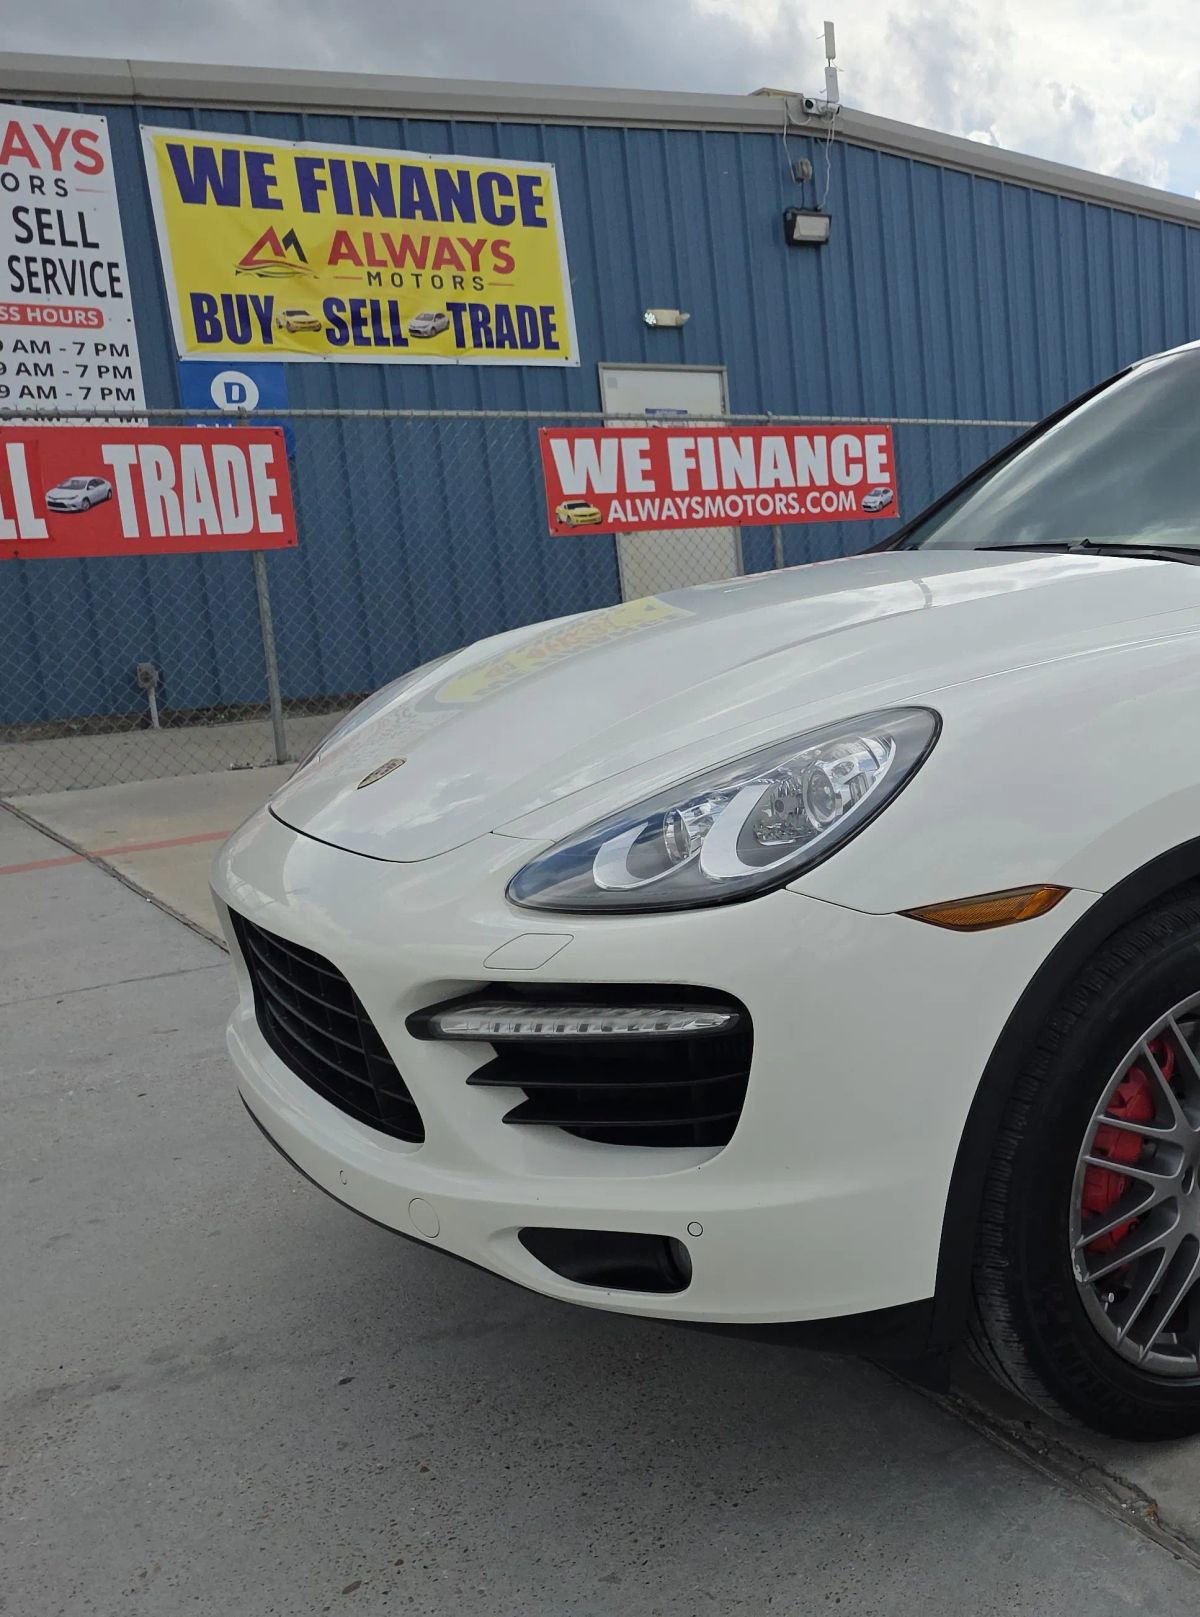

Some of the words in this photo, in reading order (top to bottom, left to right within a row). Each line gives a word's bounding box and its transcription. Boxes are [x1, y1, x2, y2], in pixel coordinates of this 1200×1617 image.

[0, 120, 104, 175] AYS
[0, 172, 68, 197] ORS
[166, 143, 284, 210] WE
[294, 156, 548, 229] FINANCE
[12, 206, 99, 249] SELL
[327, 230, 516, 274] ALWAYS
[8, 255, 123, 298] SERVICE
[368, 270, 485, 292] MOTORS
[26, 307, 99, 325] HOURS
[190, 292, 274, 344] BUY
[323, 296, 408, 347] SELL
[446, 301, 560, 351] TRADE
[12, 339, 51, 354] AM
[72, 341, 85, 355] 7
[94, 343, 130, 357] PM
[16, 362, 54, 377] AM
[75, 364, 88, 378] 7
[97, 365, 133, 379] PM
[0, 384, 10, 398] 9
[19, 385, 57, 400] AM
[78, 386, 91, 400] 7
[100, 387, 136, 401] PM
[224, 382, 247, 404] D
[550, 437, 655, 495] WE
[667, 434, 890, 492] FINANCE
[101, 443, 284, 539] TRADE
[607, 490, 856, 524] ALWAYSMOTORS.COM
